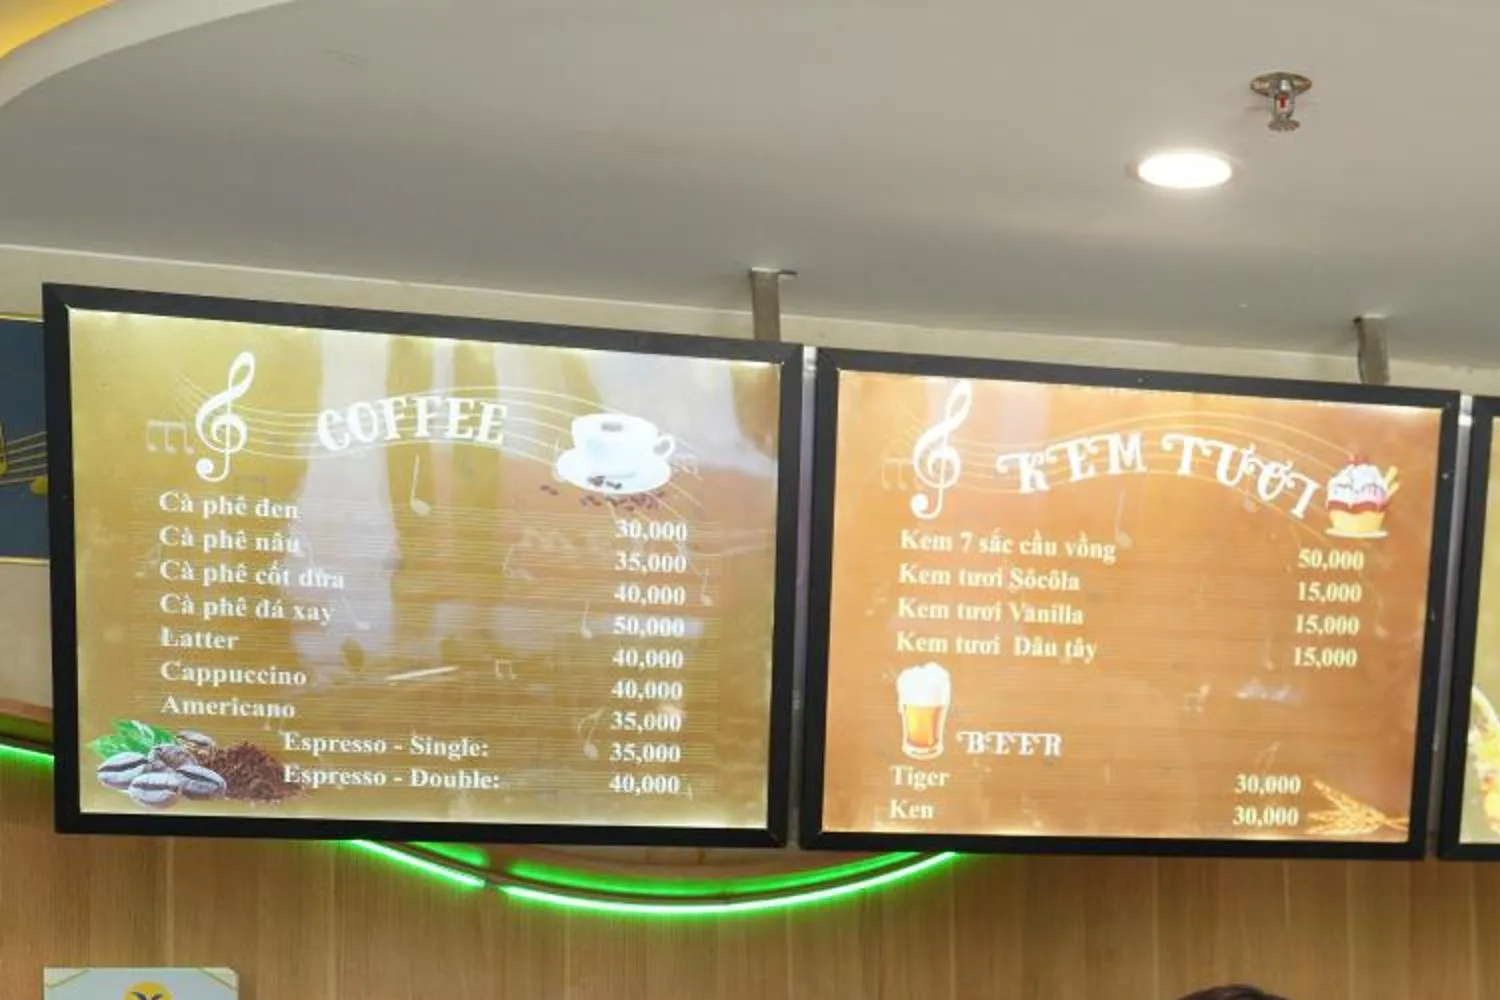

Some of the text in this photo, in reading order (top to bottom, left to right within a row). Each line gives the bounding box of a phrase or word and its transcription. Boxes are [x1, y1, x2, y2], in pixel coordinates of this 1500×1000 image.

[318, 397, 508, 451] COFFEE
[996, 432, 1320, 519] KEM TƯƠI
[159, 489, 299, 519] Cà phê đen
[159, 525, 301, 553] Cà phê nâu
[614, 519, 688, 542] 30,000
[900, 527, 1117, 565] Kem 7 sắc cầu vồng
[614, 552, 687, 575] 35,000
[1298, 547, 1365, 572] 50,000
[159, 559, 195, 581] Cà
[203, 563, 248, 586] phê
[255, 560, 290, 586] cốt
[899, 563, 951, 585] Kem
[958, 568, 1003, 588] tươi
[613, 584, 686, 606] 40,000
[1298, 581, 1363, 604] 15,000
[159, 592, 335, 627] Cà phê đá xay
[897, 597, 1084, 625] Kem tươi Vanilla
[613, 616, 685, 638] 50,000
[1296, 613, 1360, 636] 15,000
[160, 626, 240, 650] Latter
[896, 630, 1097, 664] Kem tươi Dâu tây
[612, 648, 684, 671] 40,000
[1294, 646, 1358, 669] 15,000
[160, 660, 307, 687] Cappuccino
[611, 679, 683, 702] 40,000
[160, 695, 296, 719] Americano
[610, 711, 682, 734] 35,000
[283, 731, 387, 757] Espresso
[409, 735, 489, 761] Single:
[609, 742, 681, 765] 35,000
[955, 731, 1063, 756] BEER
[283, 764, 387, 788] Espresso
[409, 767, 500, 790] Double:
[608, 773, 679, 796] 40,000
[889, 765, 950, 792] Tiger
[1234, 773, 1301, 797] 30,000
[889, 798, 934, 819] Ken
[1232, 805, 1299, 828] 30,000
